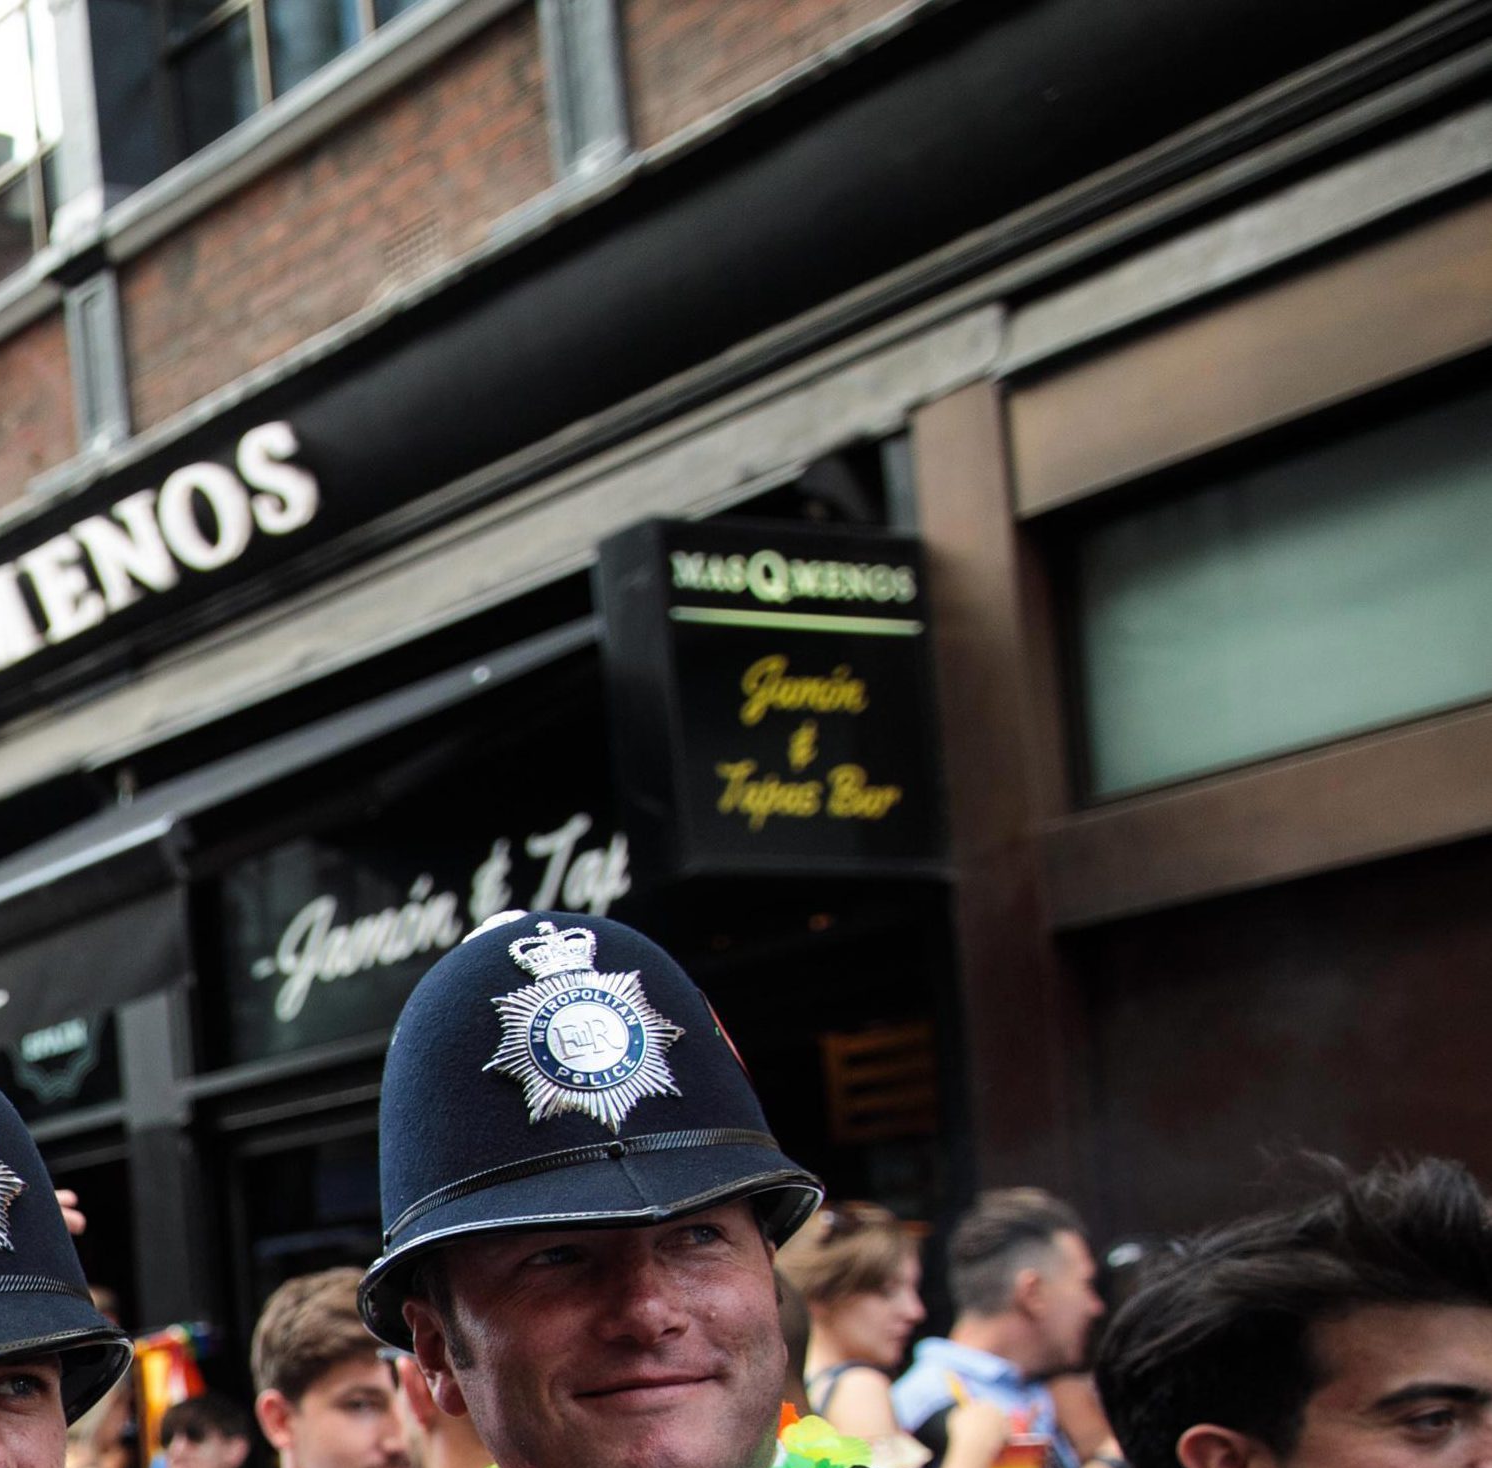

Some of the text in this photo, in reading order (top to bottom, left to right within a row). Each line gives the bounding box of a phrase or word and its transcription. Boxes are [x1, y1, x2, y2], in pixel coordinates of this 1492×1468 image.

[826, 763, 903, 820] Bar
[531, 988, 638, 1043] METROPOLITAN
[555, 1059, 637, 1086] POLICE
